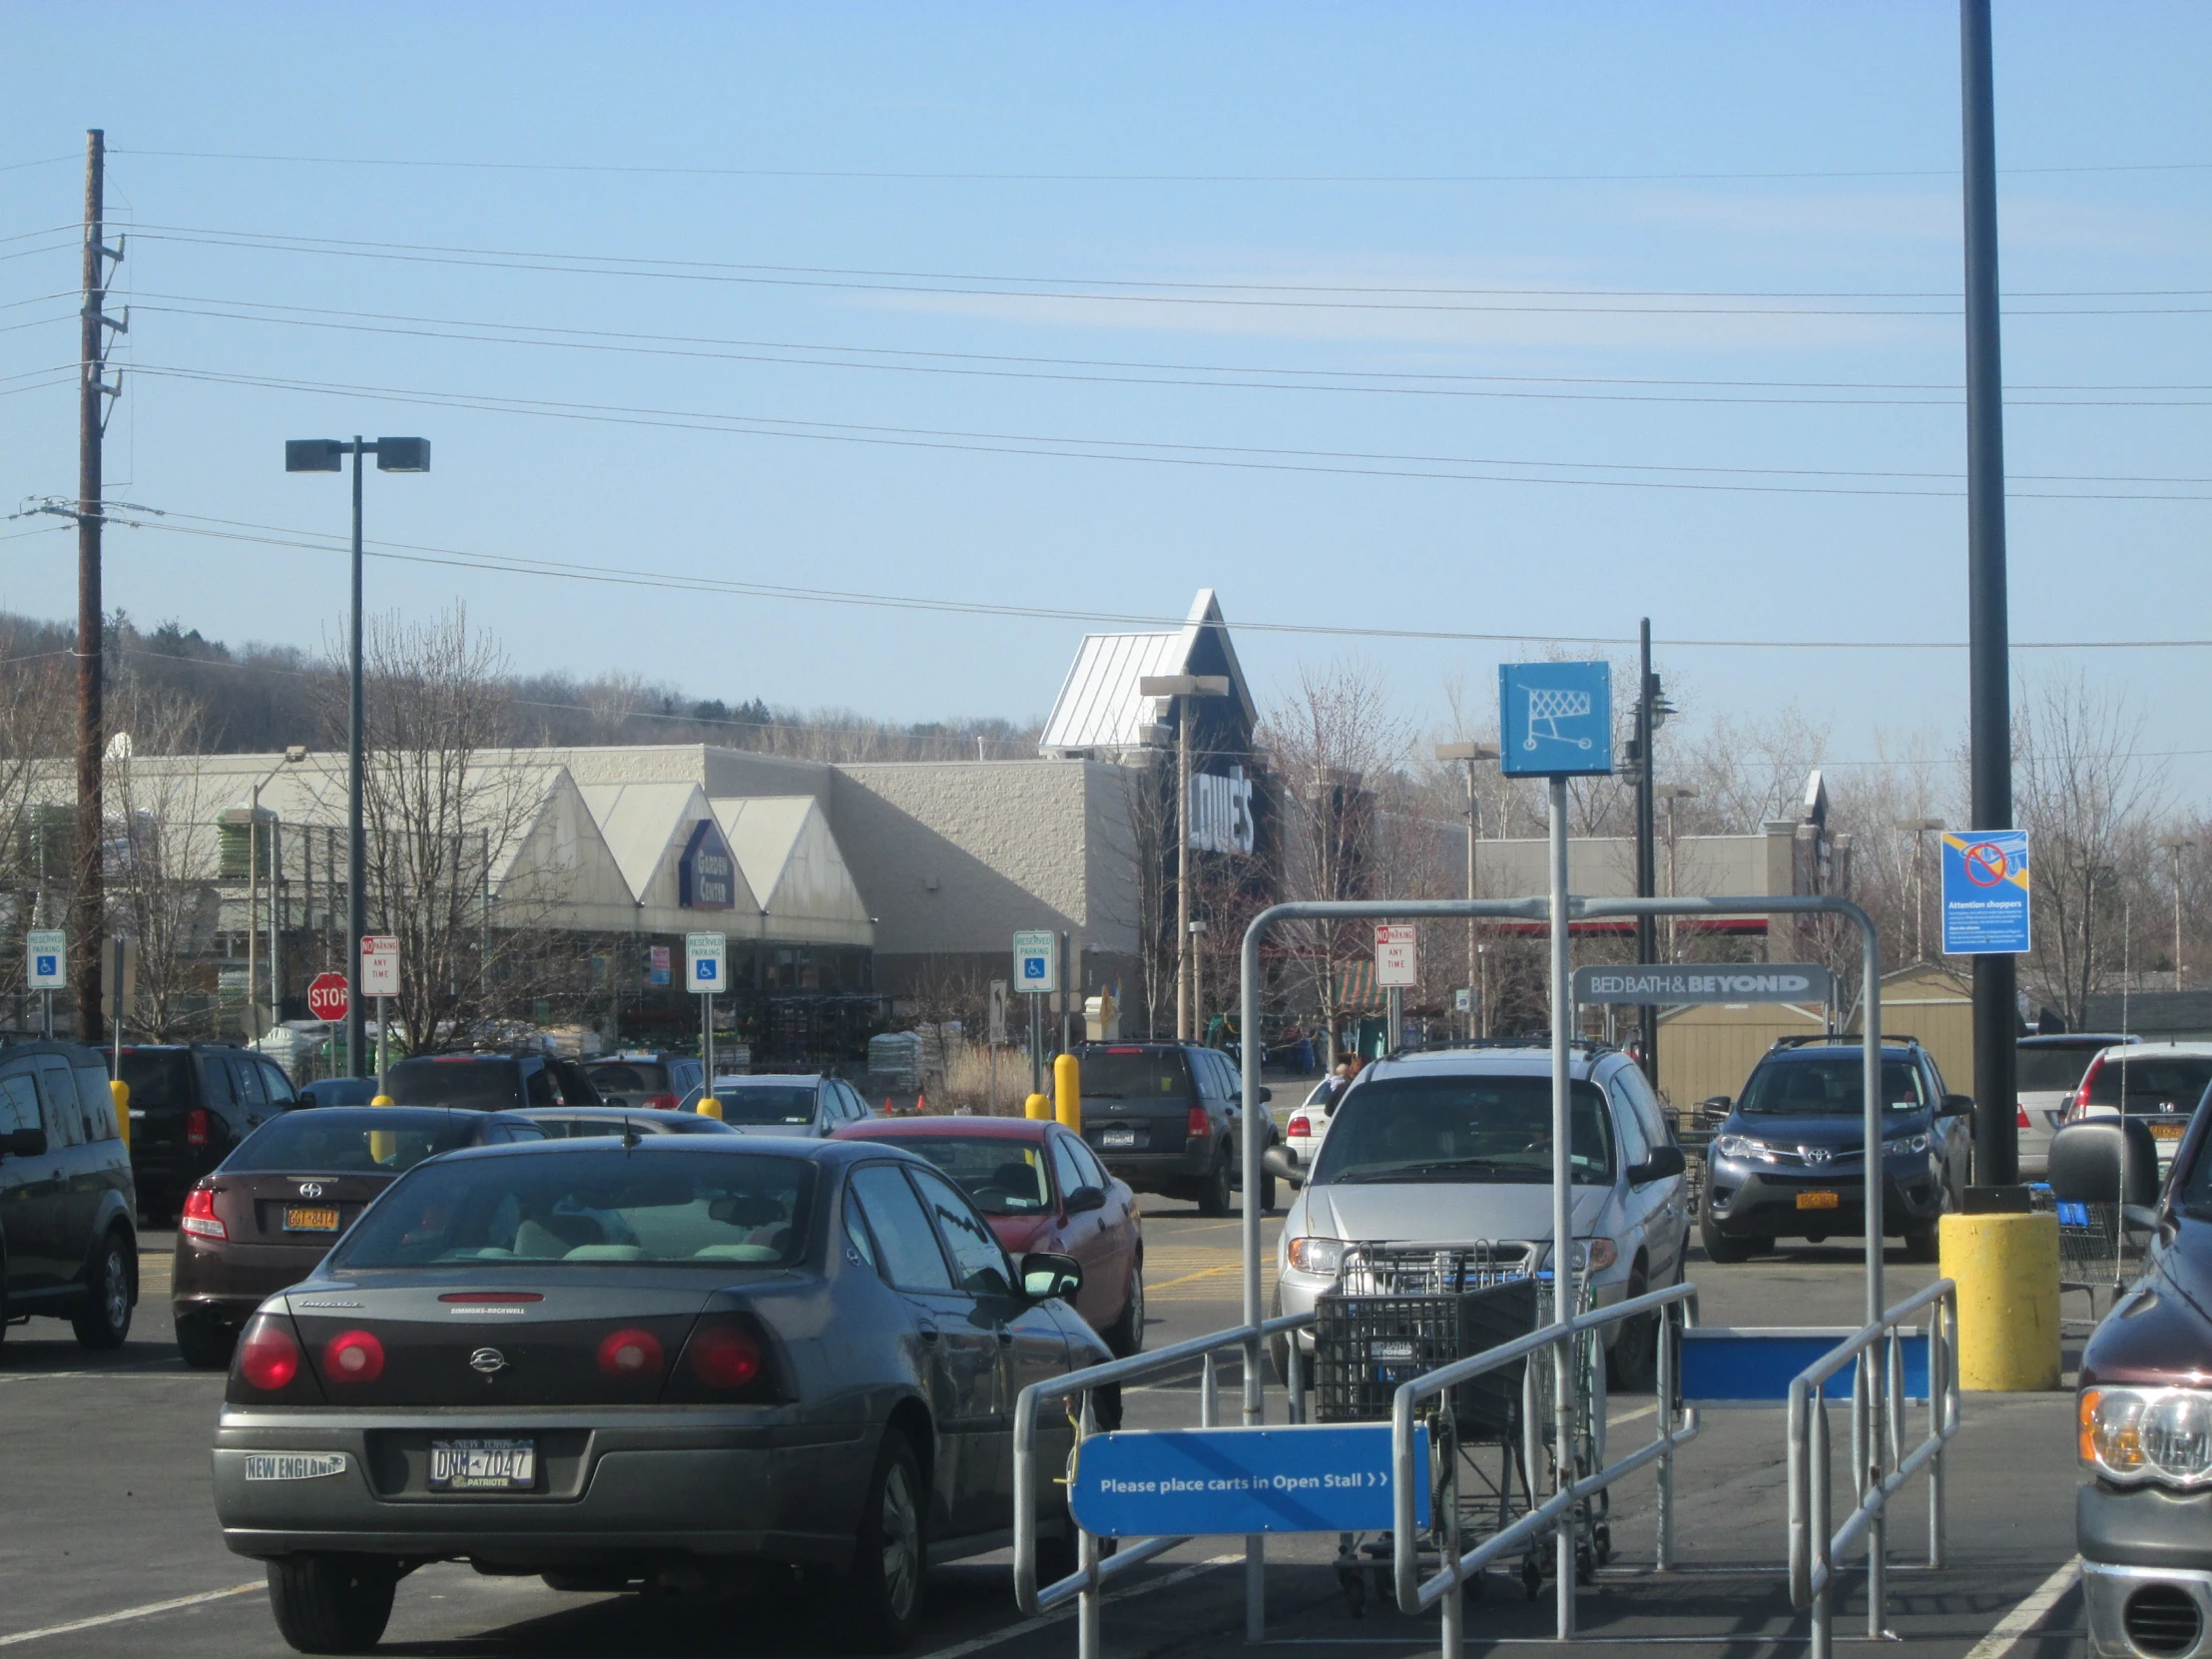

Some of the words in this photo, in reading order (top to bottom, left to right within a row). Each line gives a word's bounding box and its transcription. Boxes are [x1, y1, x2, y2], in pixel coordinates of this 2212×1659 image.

[698, 850, 728, 875] GARDEN
[700, 875, 727, 902] CENTER
[1986, 900, 2021, 909] shoppers
[689, 937, 723, 947] RESERVED
[1378, 929, 1388, 942] NO
[362, 940, 373, 952] NO
[691, 948, 721, 957] PARKING
[1591, 975, 1624, 993] BED
[1625, 975, 1670, 993] BATH
[1671, 974, 1687, 992] &
[1688, 973, 1810, 993] BEYOND
[455, 1439, 478, 1449] NEW
[483, 1439, 510, 1449] YORK
[248, 1457, 276, 1477] NEW
[1100, 1478, 1156, 1493] Please
[1160, 1477, 1204, 1495] place
[1208, 1477, 1249, 1490] carts
[1253, 1475, 1269, 1489] in
[1273, 1474, 1320, 1491] Open
[1324, 1473, 1362, 1487] Stall
